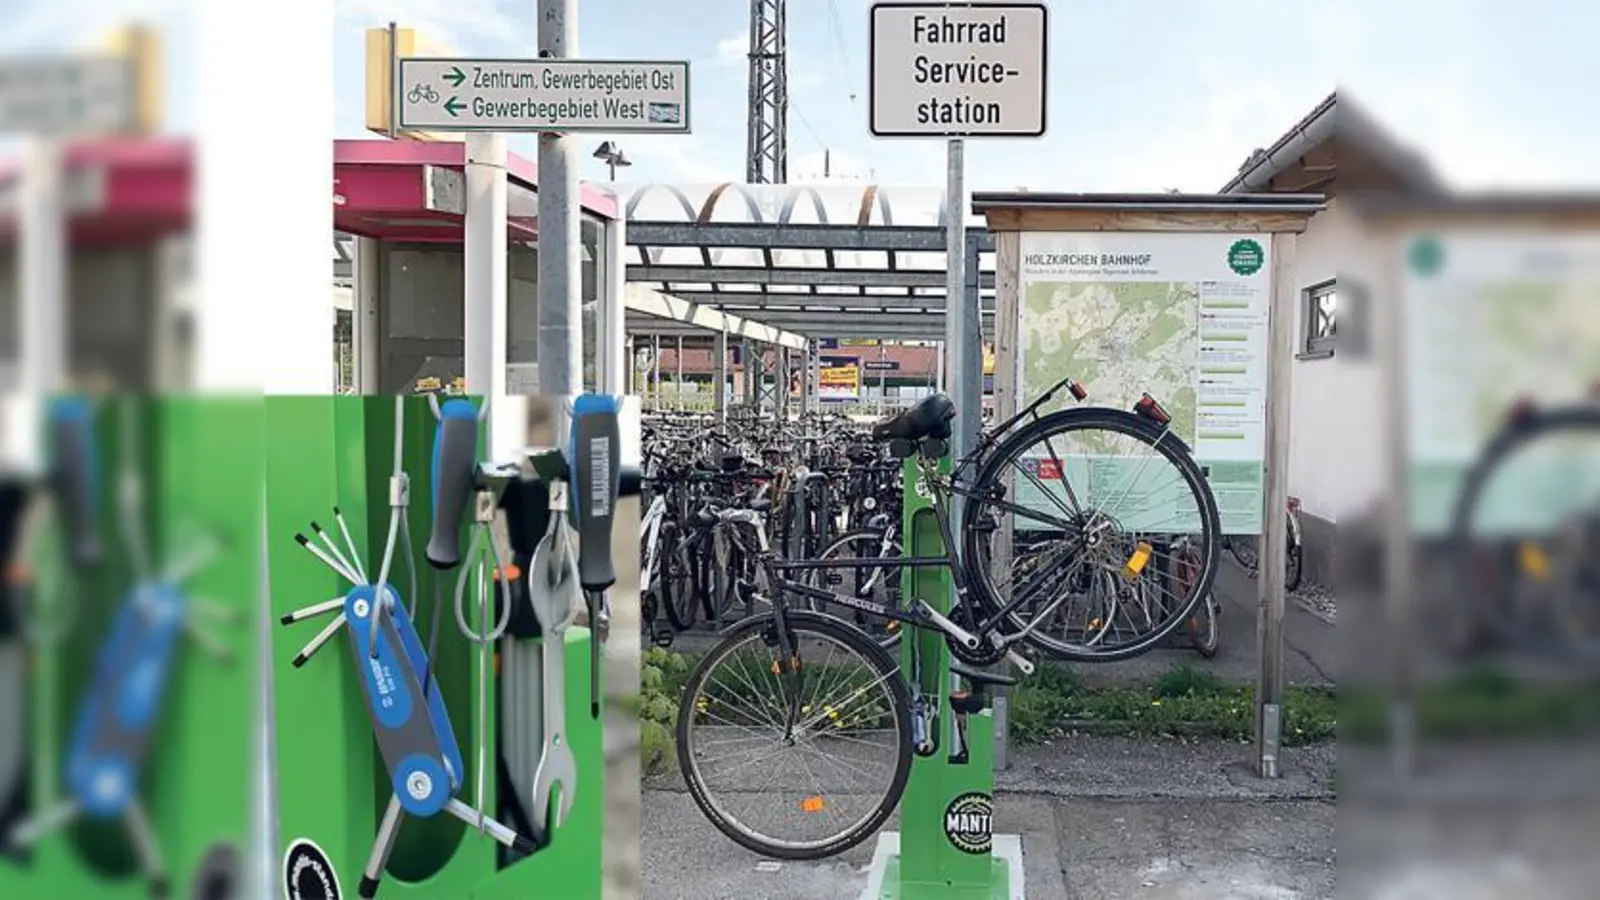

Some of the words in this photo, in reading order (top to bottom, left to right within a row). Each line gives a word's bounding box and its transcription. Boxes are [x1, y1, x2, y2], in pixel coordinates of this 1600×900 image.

[914, 15, 1006, 43] Fahrrad
[473, 67, 539, 90] Zentrum,
[542, 68, 648, 94] Gewerbegebiet
[651, 69, 675, 90] Ost
[914, 55, 1019, 83] Service-
[472, 97, 600, 123] Gewerbegebiet
[603, 101, 645, 119] West
[917, 96, 1000, 123] station
[1025, 253, 1098, 266] HOLZKIRCHEN
[1100, 253, 1152, 266] BAHNHOF
